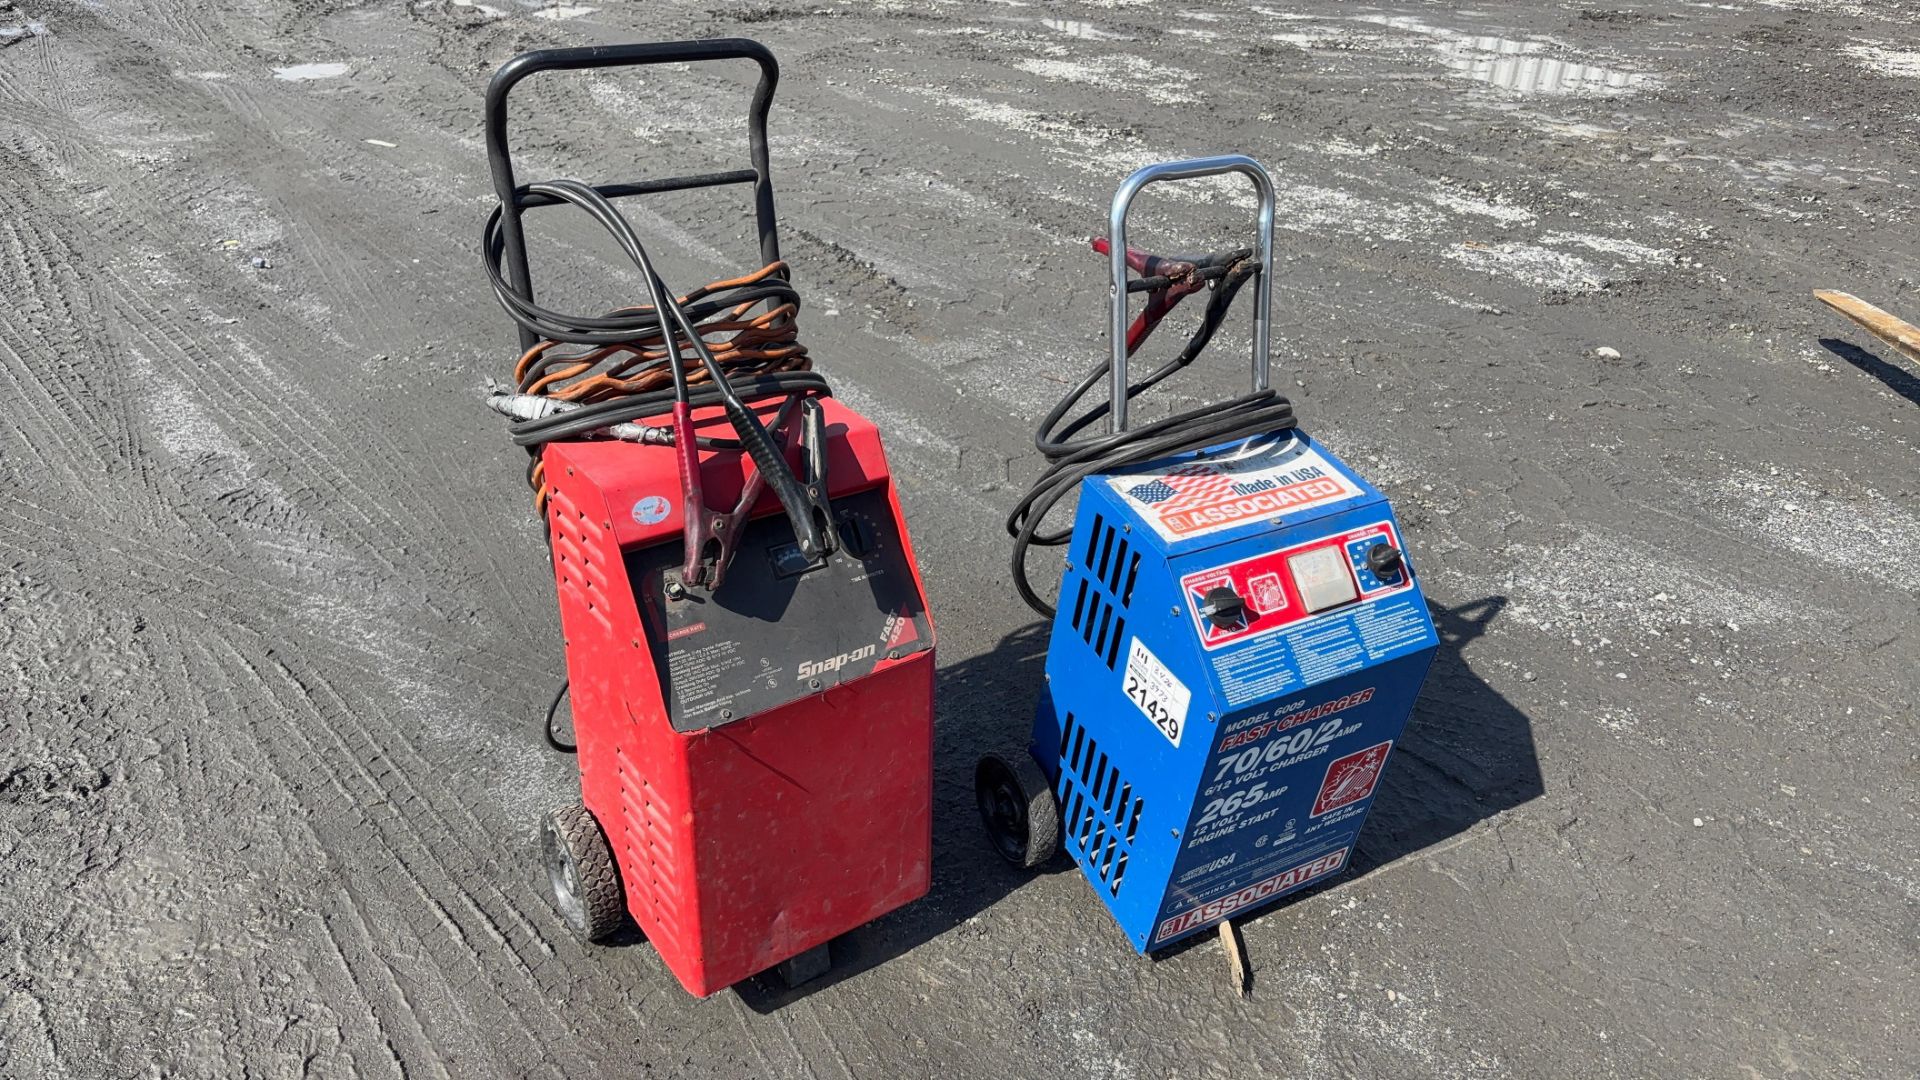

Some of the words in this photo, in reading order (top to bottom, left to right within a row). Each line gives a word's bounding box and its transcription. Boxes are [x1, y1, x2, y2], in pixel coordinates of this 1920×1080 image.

[1230, 478, 1273, 497] Made
[1279, 474, 1290, 486] in
[1293, 465, 1327, 484] USA
[1192, 480, 1337, 527] ASSOCIATED
[1207, 569, 1231, 580] VOLTAGE
[879, 608, 897, 642] FAST
[891, 616, 905, 644] 420
[797, 643, 876, 681] Snap-on
[1127, 676, 1178, 740] 21429
[1218, 721, 1276, 754] FAST
[1277, 687, 1376, 732] CHARGER
[1224, 711, 1270, 734] MODEL
[1274, 700, 1306, 717] 6009
[1213, 718, 1343, 782] 70/60/2
[1332, 722, 1363, 739] AMP
[1204, 780, 1232, 797] 6/12
[1235, 766, 1268, 785] VOLT
[1269, 744, 1329, 773] CHARGER
[1195, 781, 1269, 827] 265
[1259, 785, 1288, 803] AMP
[1321, 810, 1343, 822] SAFE
[1343, 805, 1354, 814] IN
[1188, 823, 1237, 849] ENGINE
[1238, 808, 1280, 829] START
[1192, 826, 1207, 837] 12
[1211, 811, 1244, 830] VOLT
[1304, 823, 1323, 835] ANY
[1209, 852, 1237, 872] USA
[1185, 851, 1343, 929] ASSOCIATED
